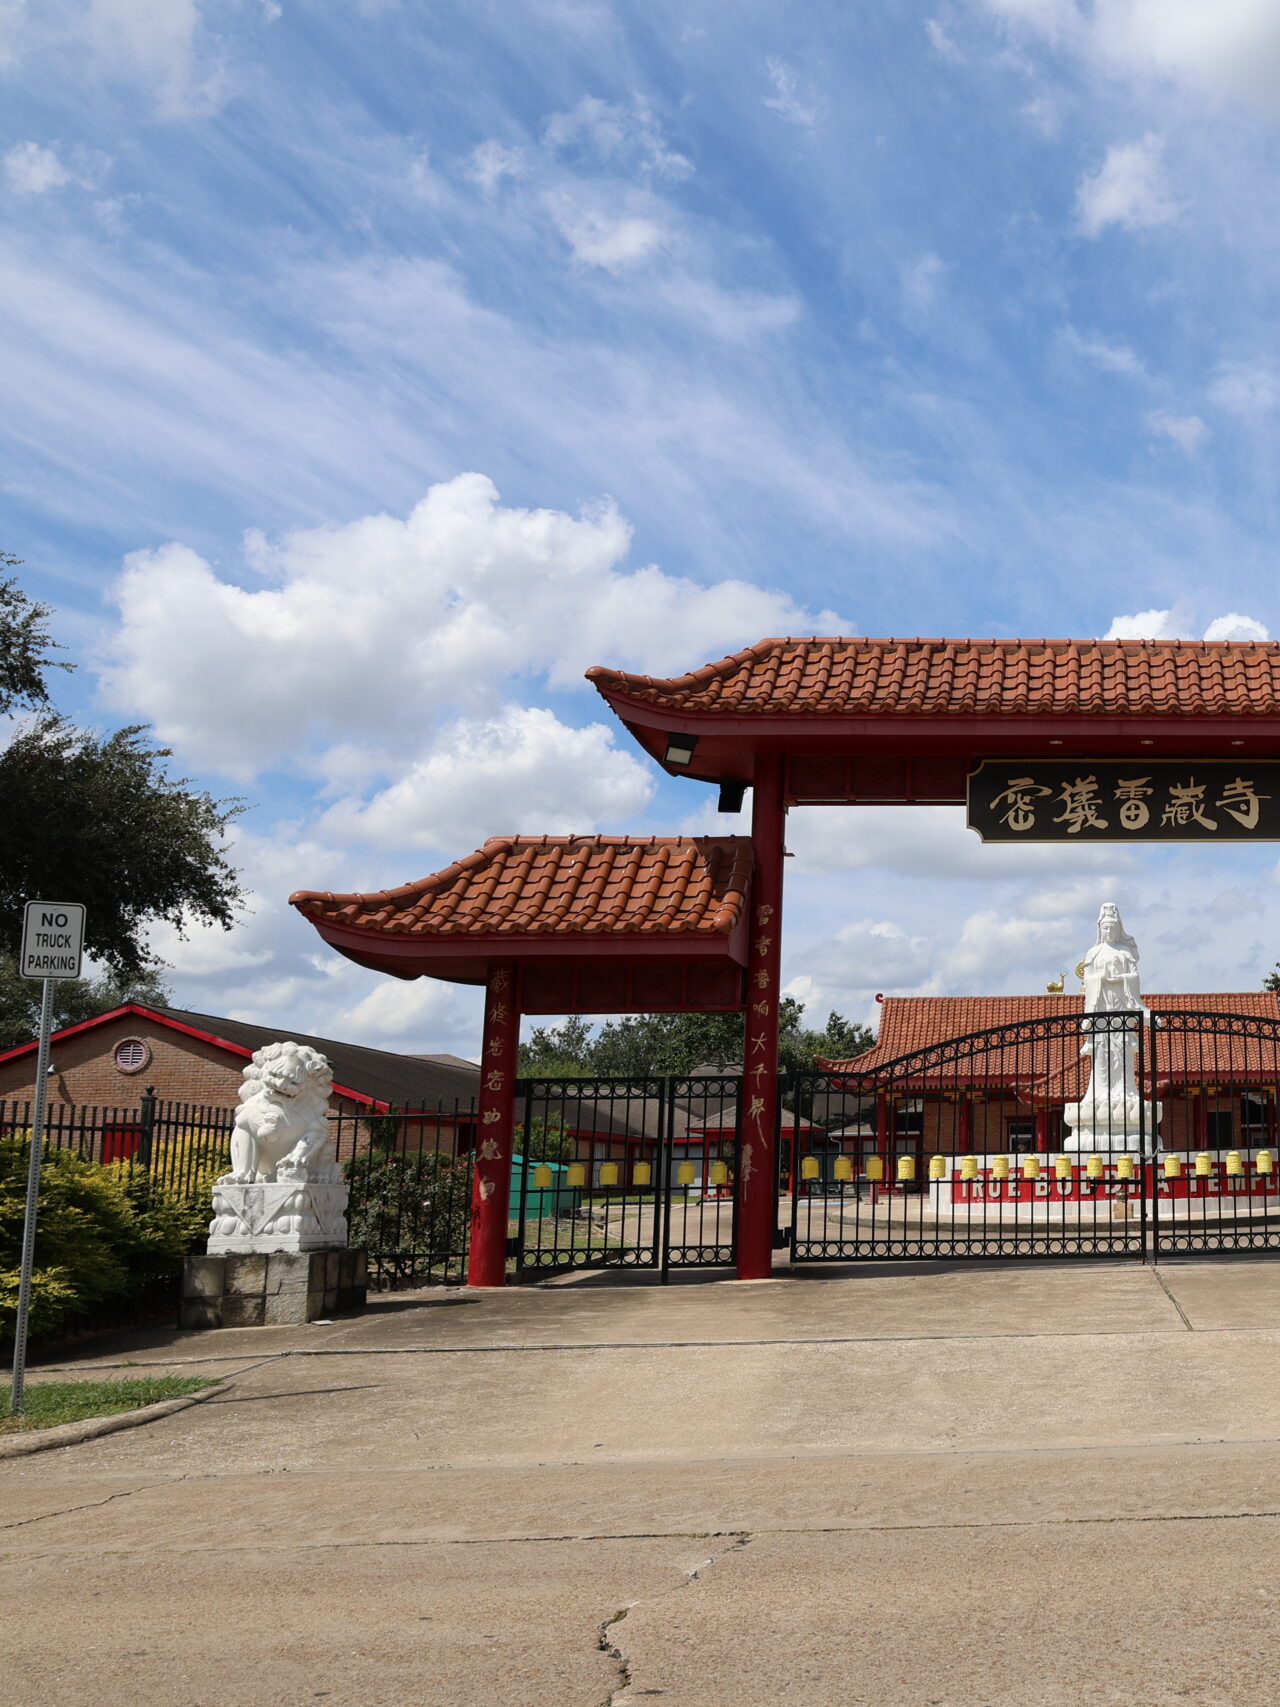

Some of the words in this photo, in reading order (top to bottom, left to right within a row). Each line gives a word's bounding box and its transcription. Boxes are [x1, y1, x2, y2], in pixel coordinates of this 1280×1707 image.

[41, 912, 68, 928] NO
[36, 933, 72, 949] TRUCK
[28, 955, 76, 971] PARKING
[960, 1171, 1021, 1198] TRUE
